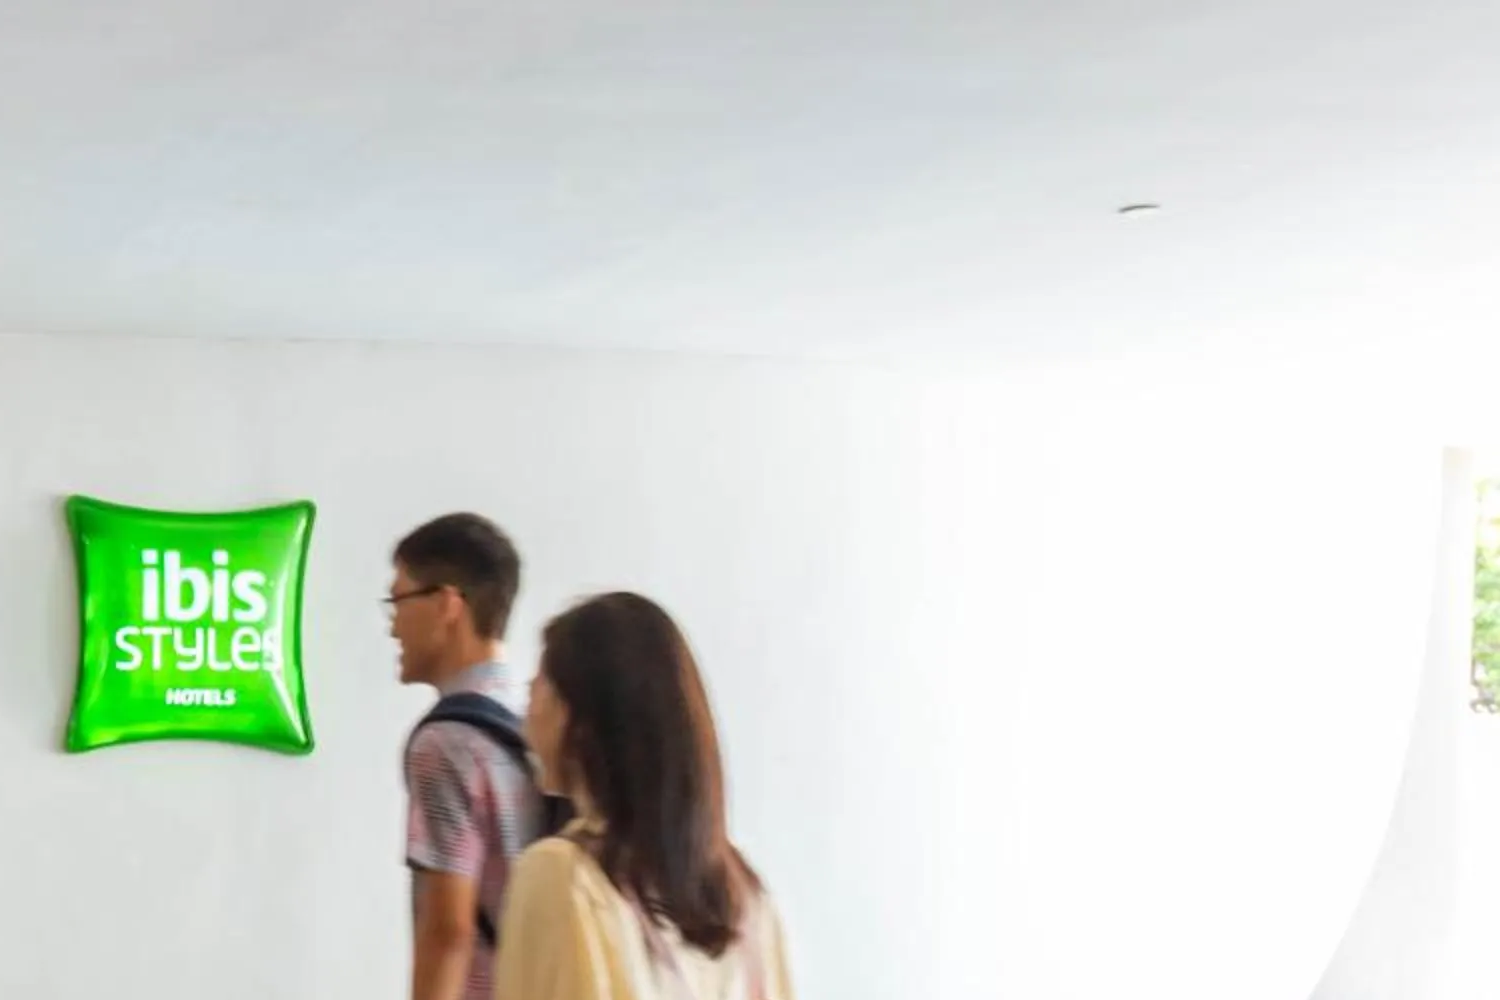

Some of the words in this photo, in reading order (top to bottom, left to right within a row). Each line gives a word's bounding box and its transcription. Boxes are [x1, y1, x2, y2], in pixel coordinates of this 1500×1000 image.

[141, 548, 269, 623] ibis
[114, 625, 282, 672] STYLES
[164, 687, 237, 706] HOTELS
